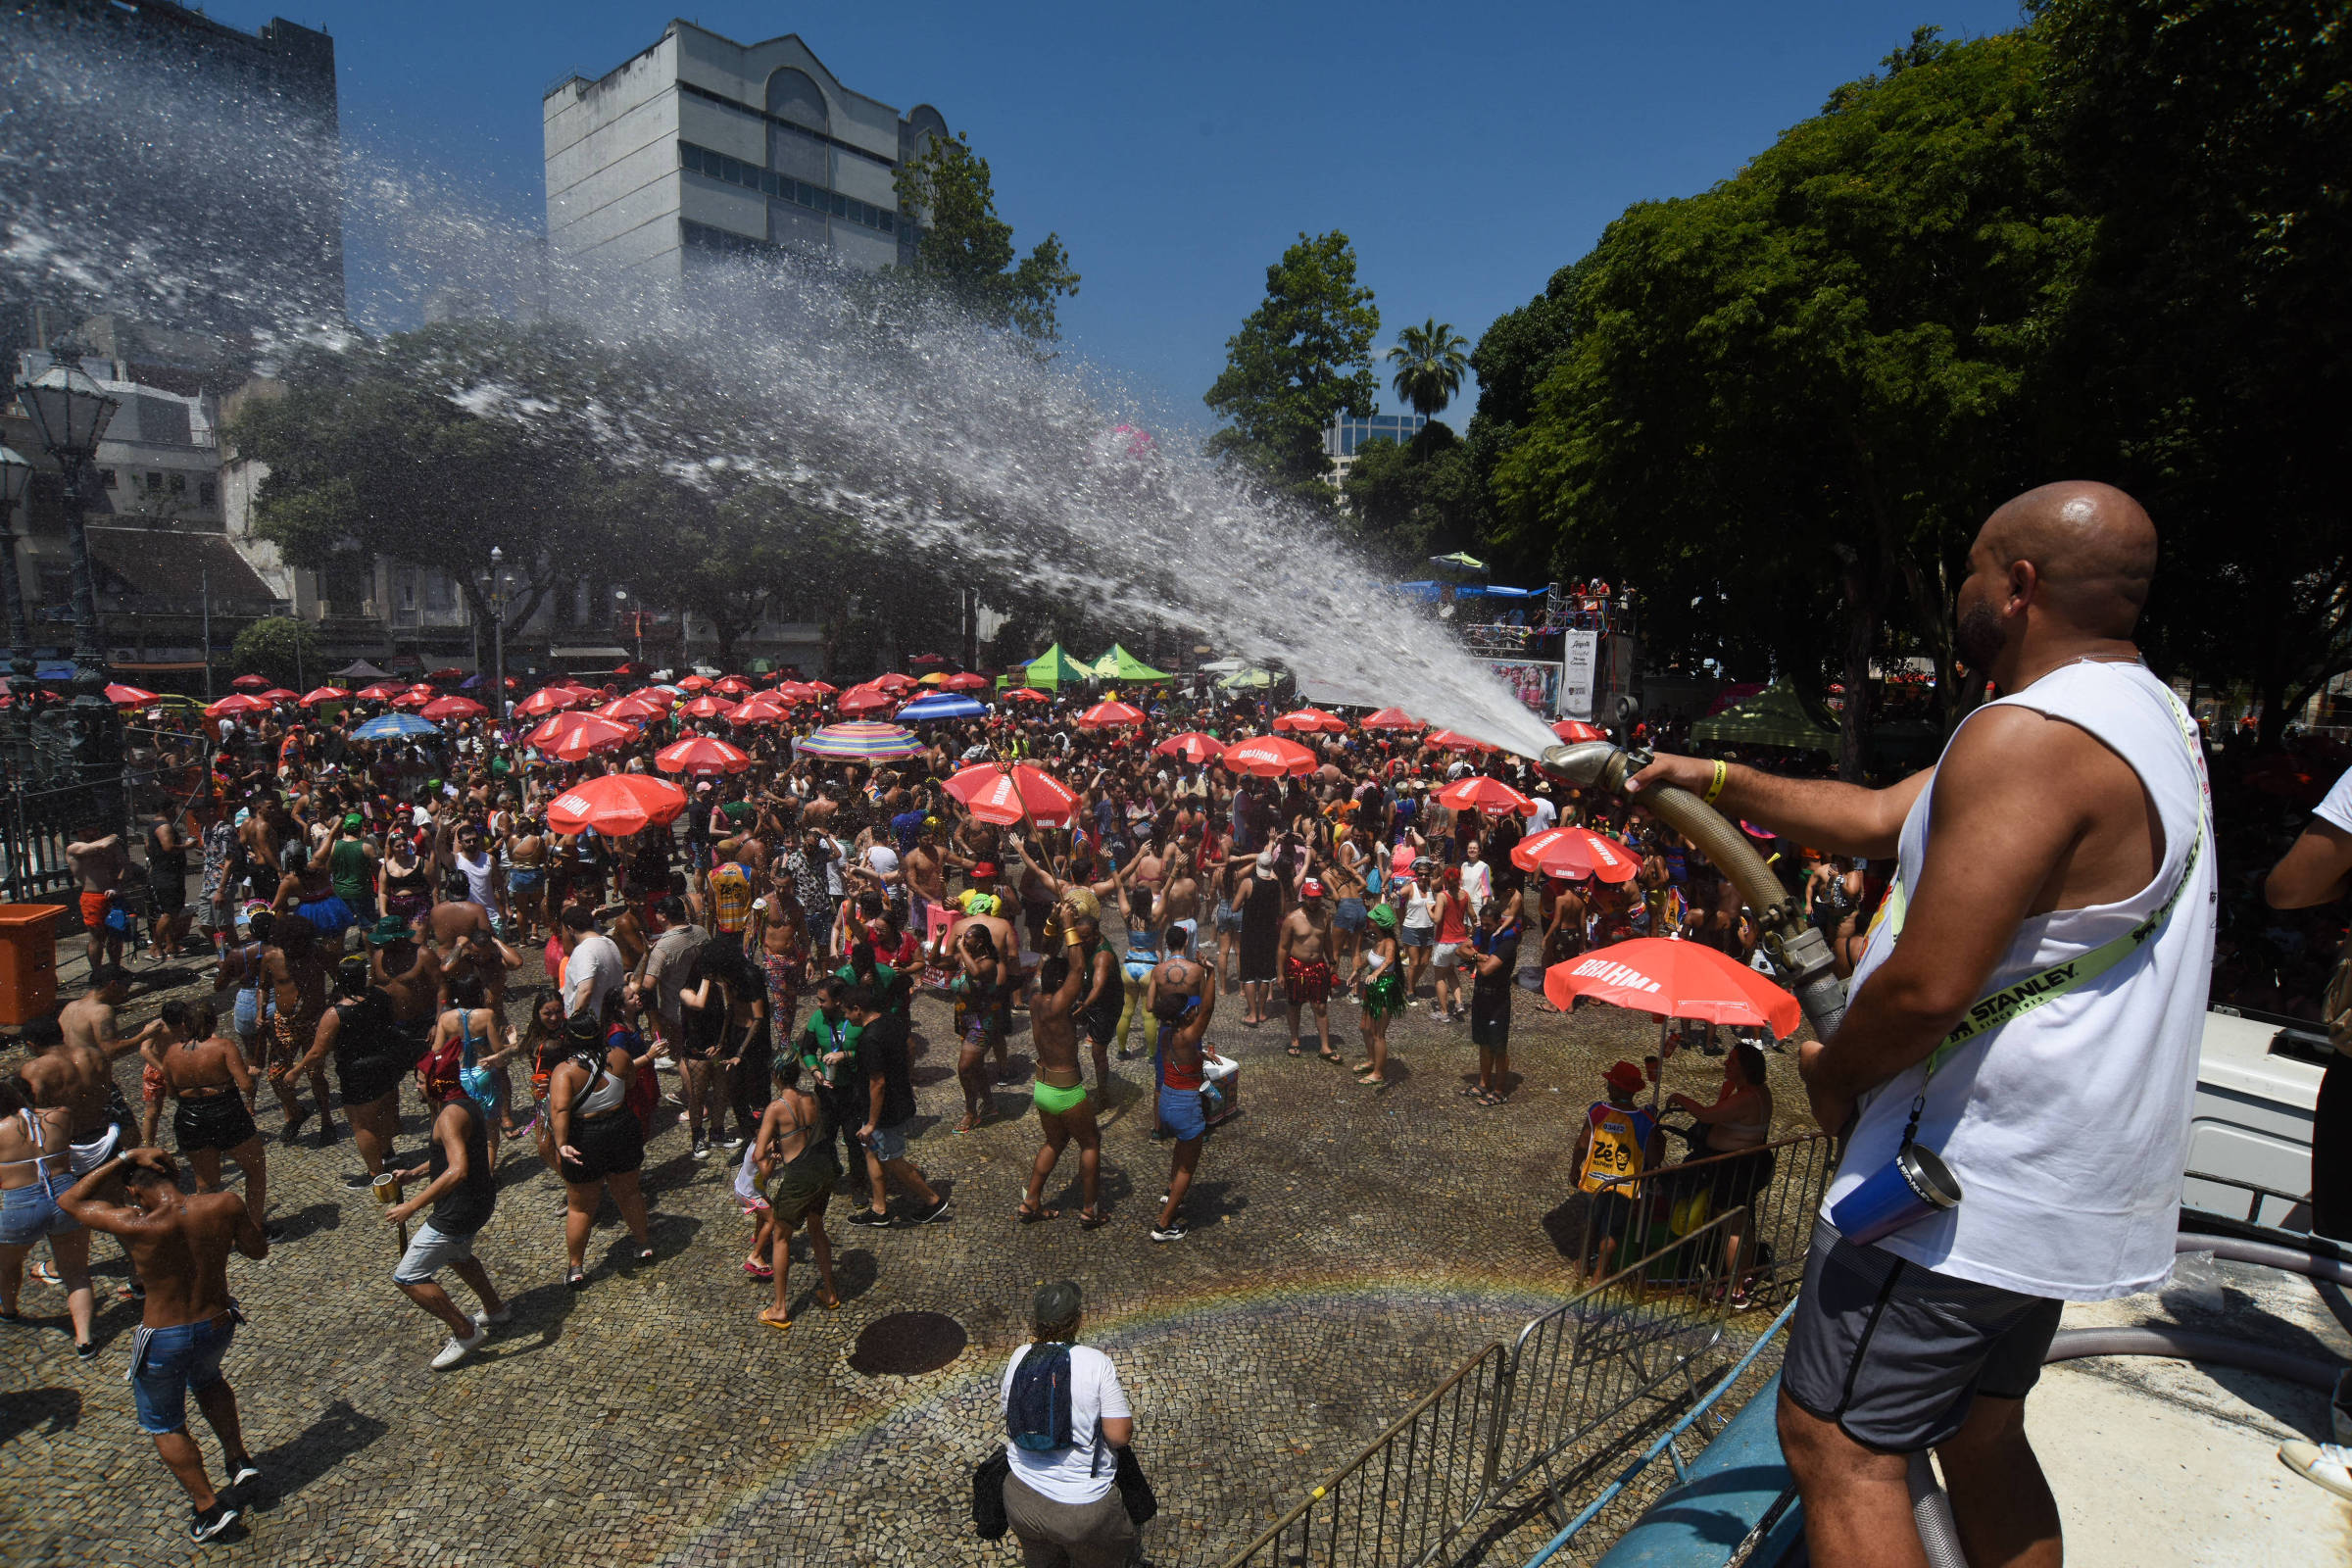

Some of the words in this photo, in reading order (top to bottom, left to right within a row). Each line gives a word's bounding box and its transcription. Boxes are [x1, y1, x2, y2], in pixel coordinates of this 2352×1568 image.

[1238, 749, 1278, 763] BRAHMA
[1526, 832, 1563, 856] BRAHMA
[1571, 959, 1662, 994] BRAHMA
[1970, 962, 2075, 1022] STANLEY
[1980, 1010, 2013, 1029] SINCE
[2019, 997, 2043, 1011] 1913
[1594, 1141, 1613, 1162] Zé
